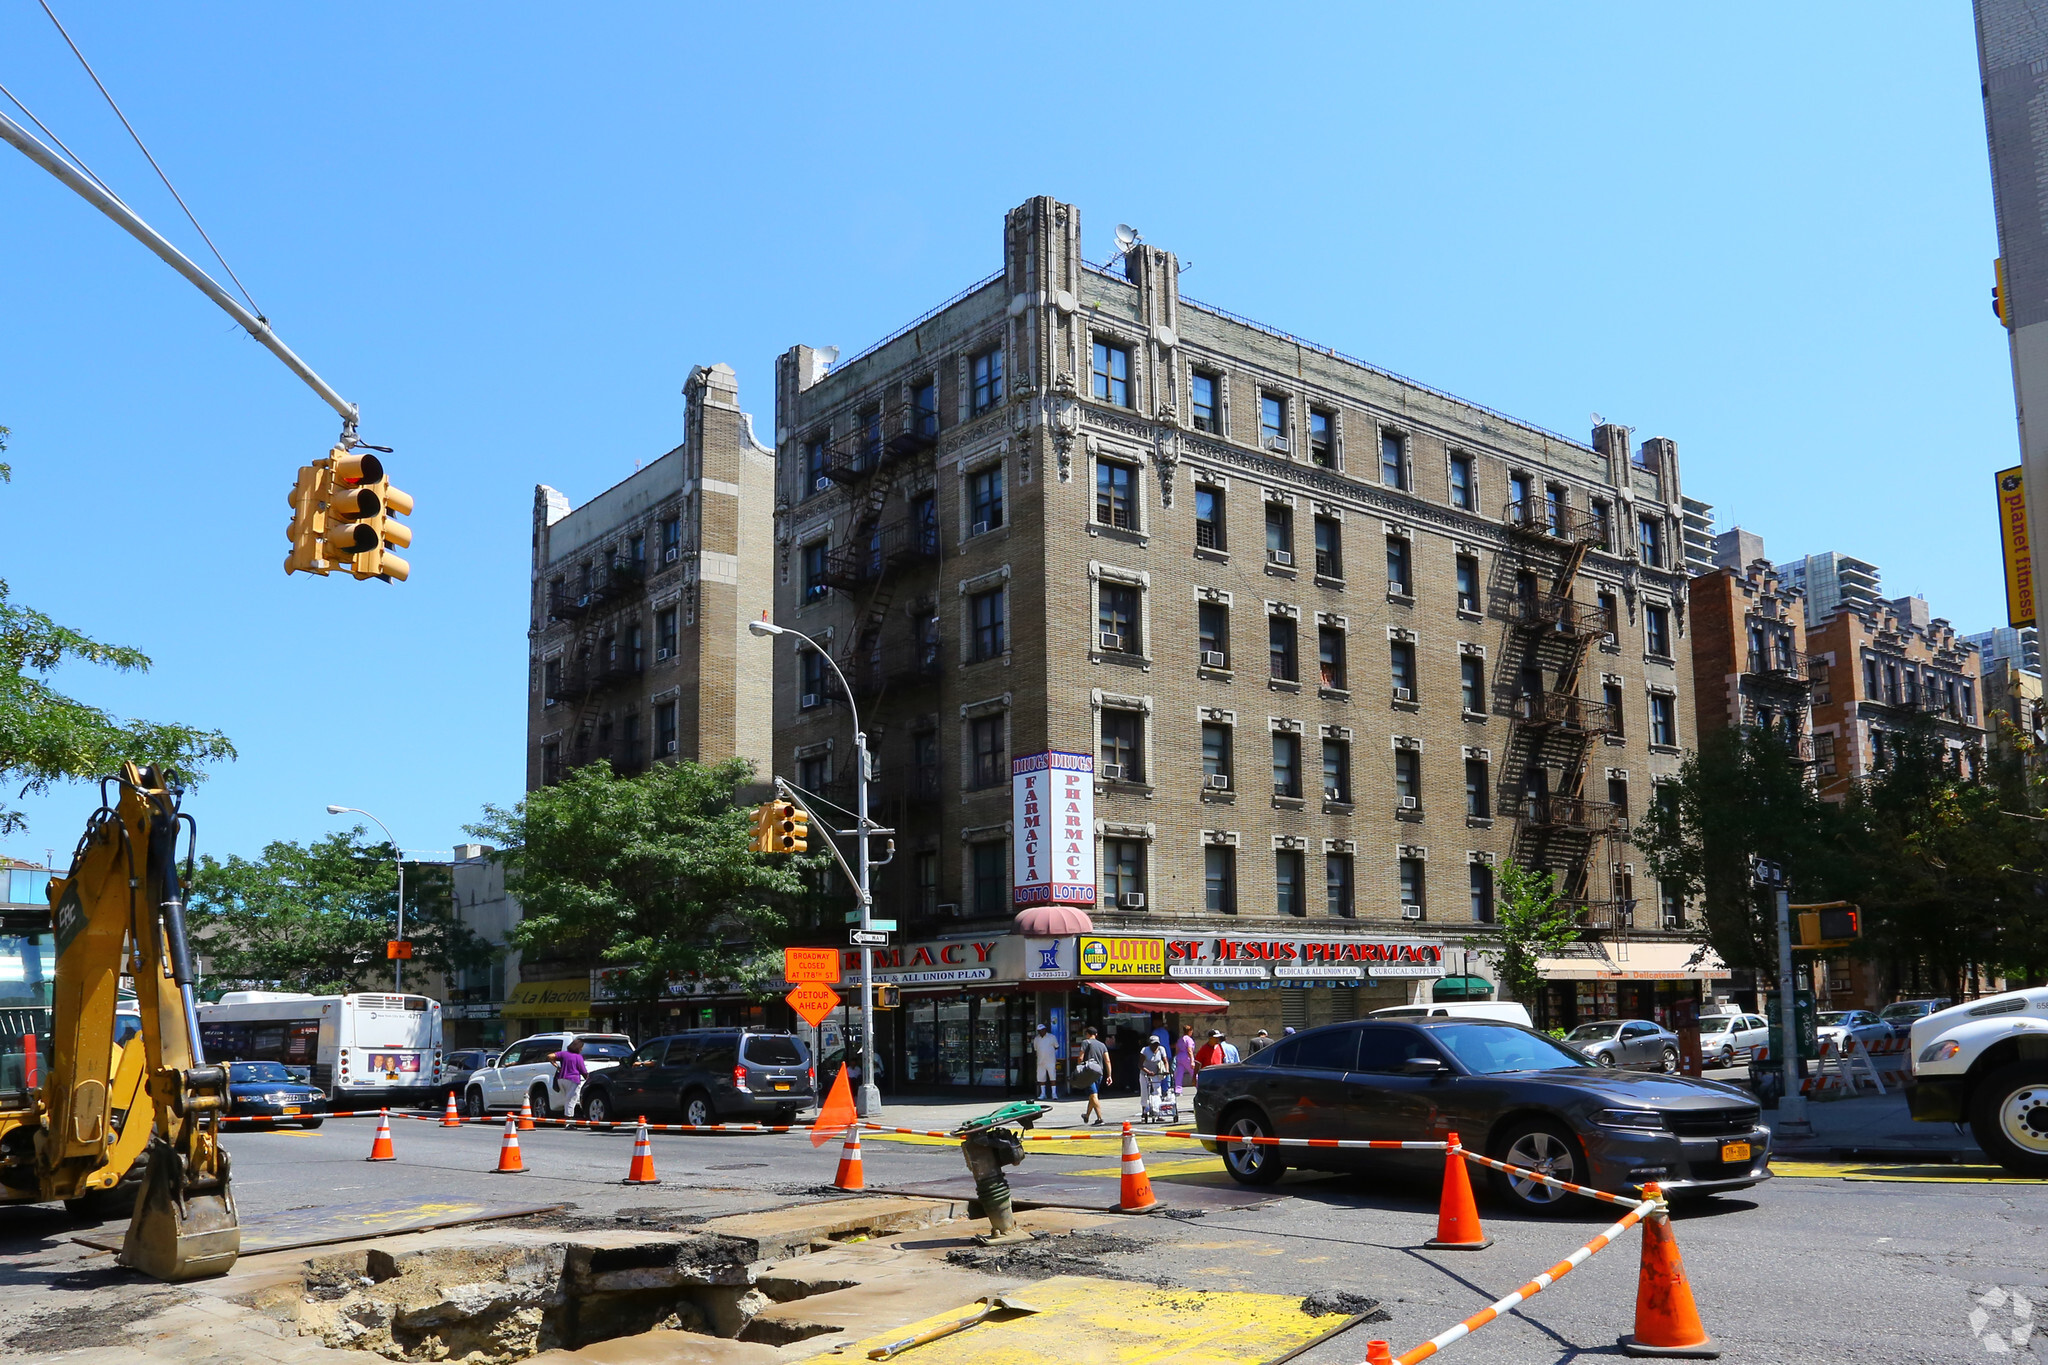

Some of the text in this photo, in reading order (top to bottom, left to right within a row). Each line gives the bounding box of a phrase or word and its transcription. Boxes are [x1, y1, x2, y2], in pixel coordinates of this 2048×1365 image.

[2005, 493, 2029, 553] planet
[2015, 556, 2033, 618] fitness
[1013, 753, 1049, 774] DRUGS
[1051, 752, 1093, 772] DRUGS
[1023, 775, 1041, 882] FARMACIA
[1064, 774, 1083, 880] PHARMACY
[1015, 885, 1050, 903] LOTTO
[1053, 885, 1094, 901] LOTTO
[793, 952, 830, 960] BROADWAY
[842, 941, 996, 970] RMACY
[1110, 940, 1161, 961] LOTTO
[1168, 940, 1208, 960] ST.
[1216, 938, 1298, 961] JESUS
[1305, 943, 1445, 963] PHARMACY
[1110, 963, 1162, 973] PLAY HERE
[1173, 967, 1262, 975] HEALTH & BEAUTY AIDS
[1278, 967, 1304, 975] MEDICAL
[1633, 970, 1685, 979] Delicatessen
[848, 970, 986, 984] MECAL & ALL UNION PLAN
[521, 991, 535, 1004] La
[797, 991, 829, 999] DETOUR
[799, 1002, 829, 1010] AHEAD
